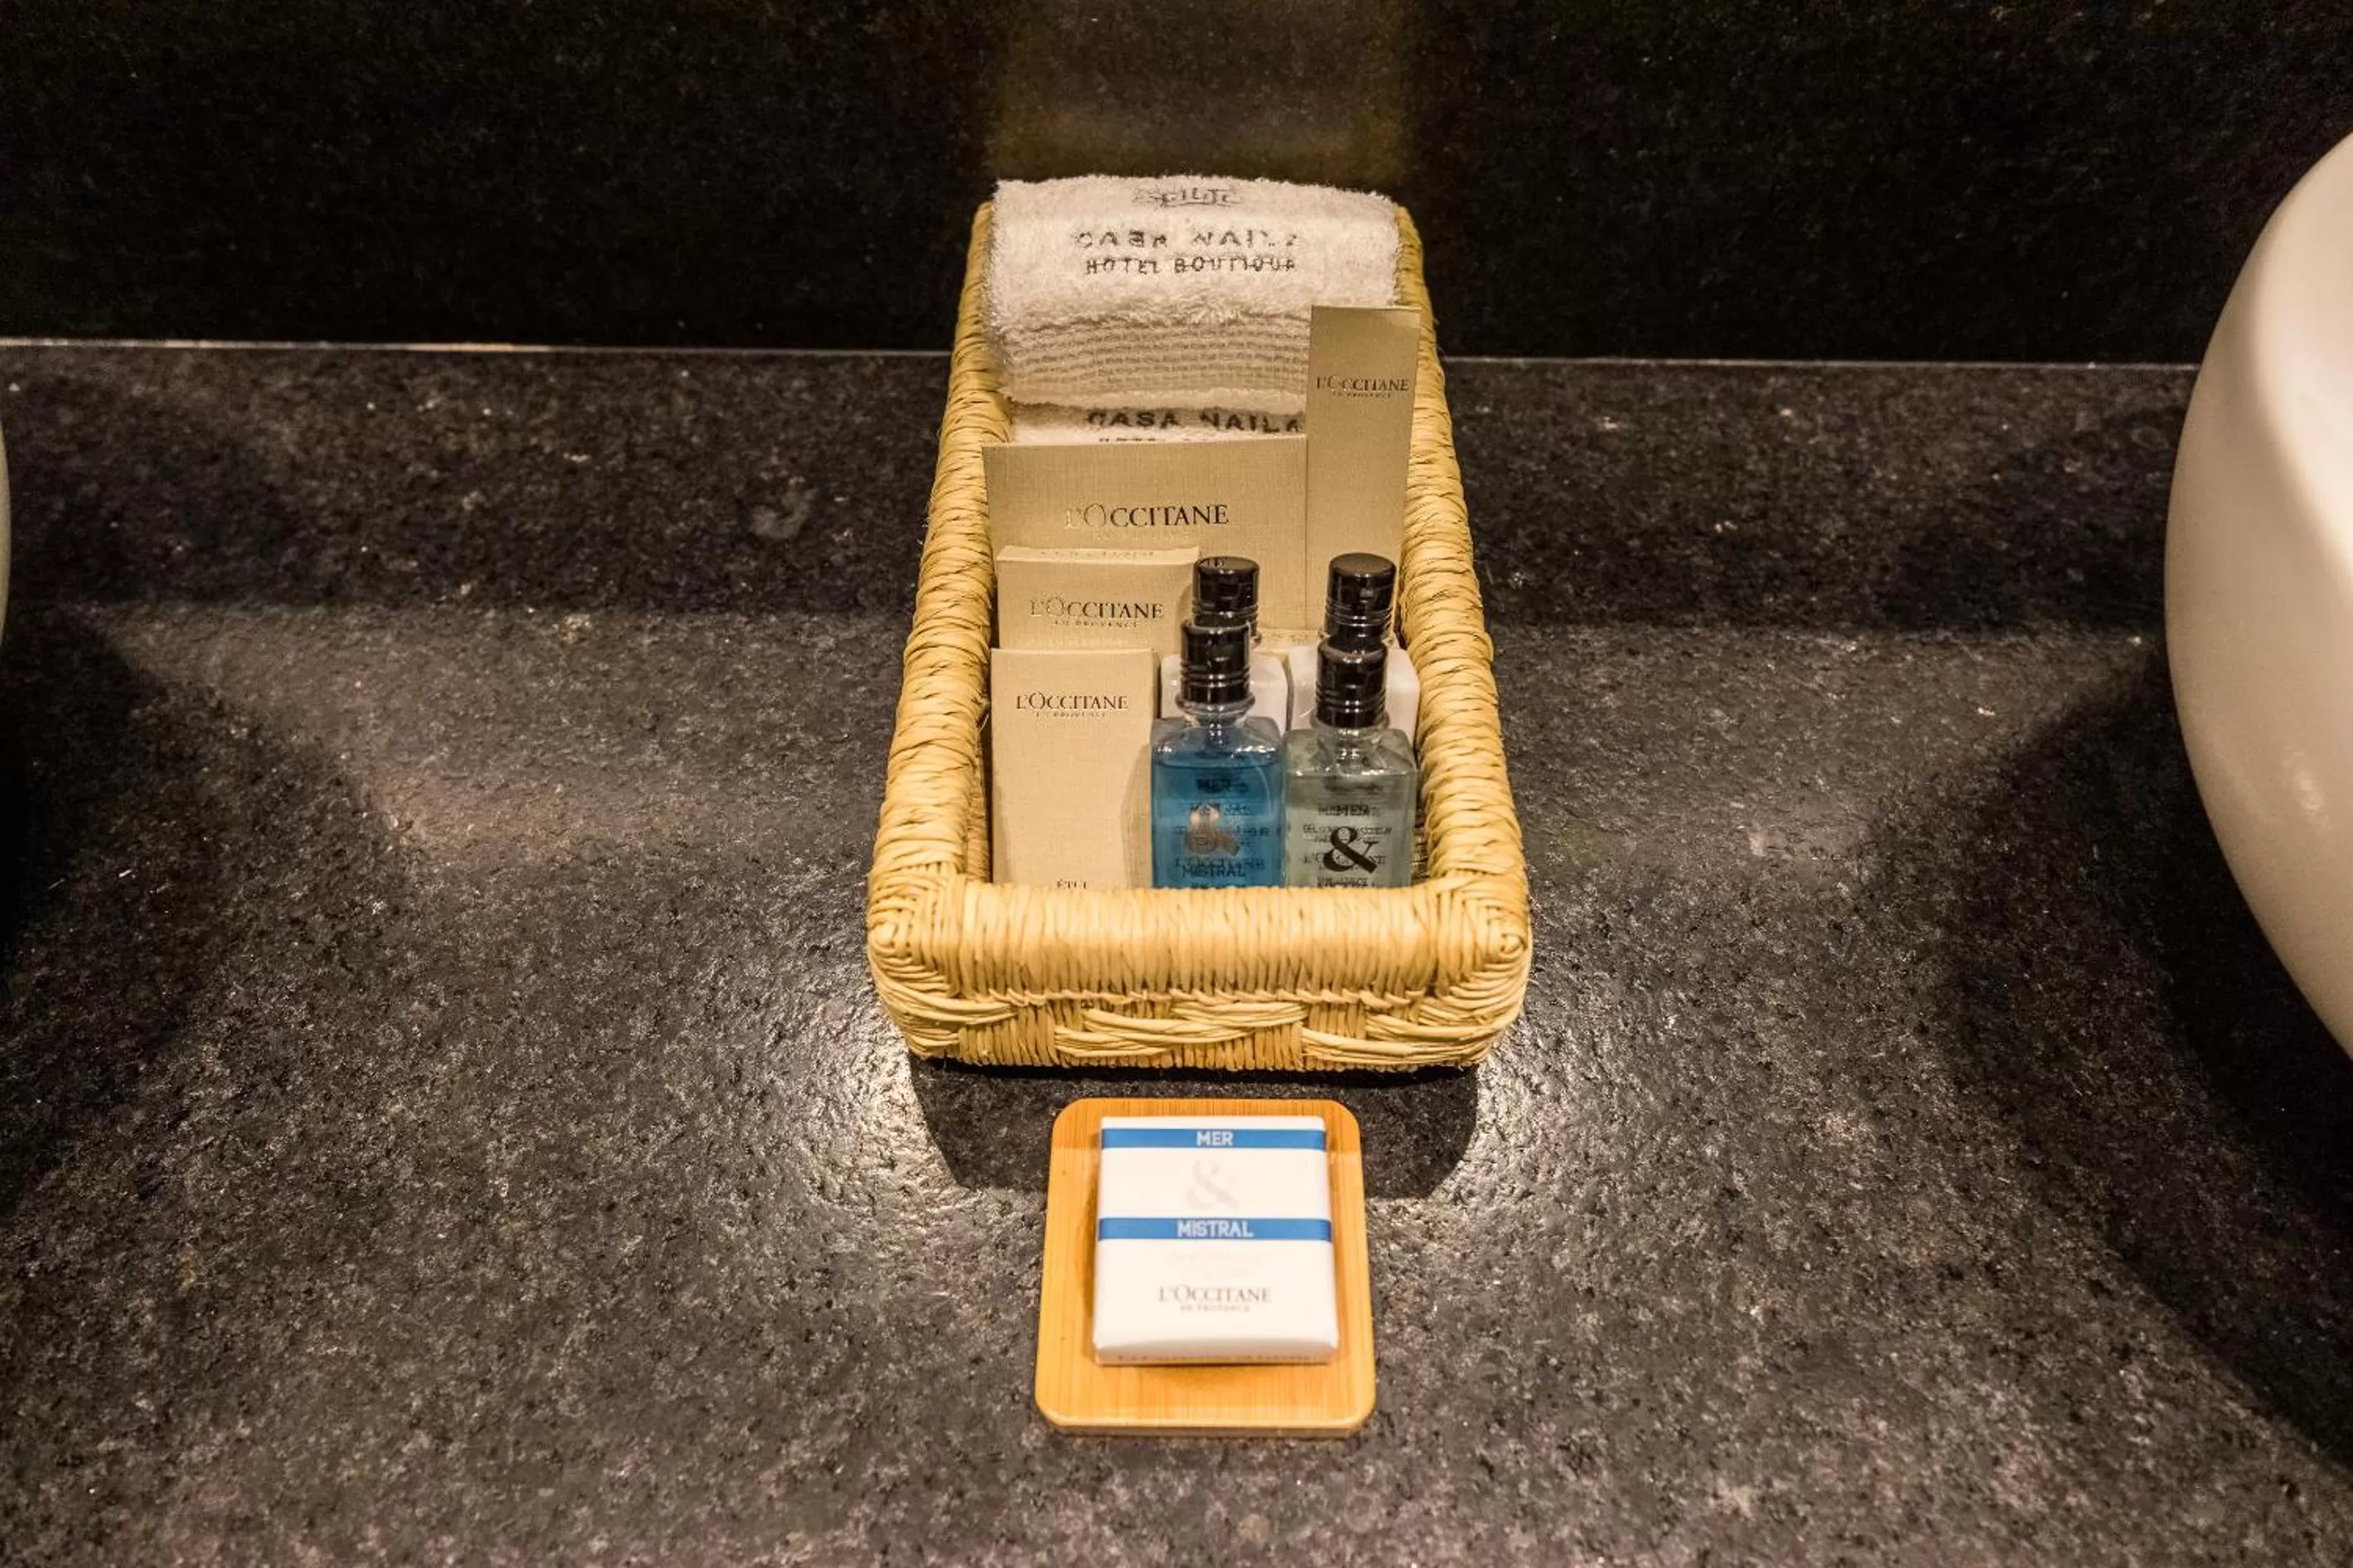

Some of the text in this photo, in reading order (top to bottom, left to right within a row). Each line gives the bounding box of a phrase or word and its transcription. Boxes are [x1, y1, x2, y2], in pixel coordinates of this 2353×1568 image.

[1086, 257, 1160, 274] HOTEL
[1065, 503, 1230, 529] L'OCCITANE
[1030, 596, 1164, 619] L'OCCITANE
[1016, 692, 1129, 710] L'OCCITANE
[1323, 826, 1379, 874] &
[1196, 1131, 1233, 1146] MER
[1186, 1159, 1240, 1210] &
[1177, 1220, 1254, 1238] MISTRAL
[1158, 1283, 1273, 1303] L'OCCITANE
